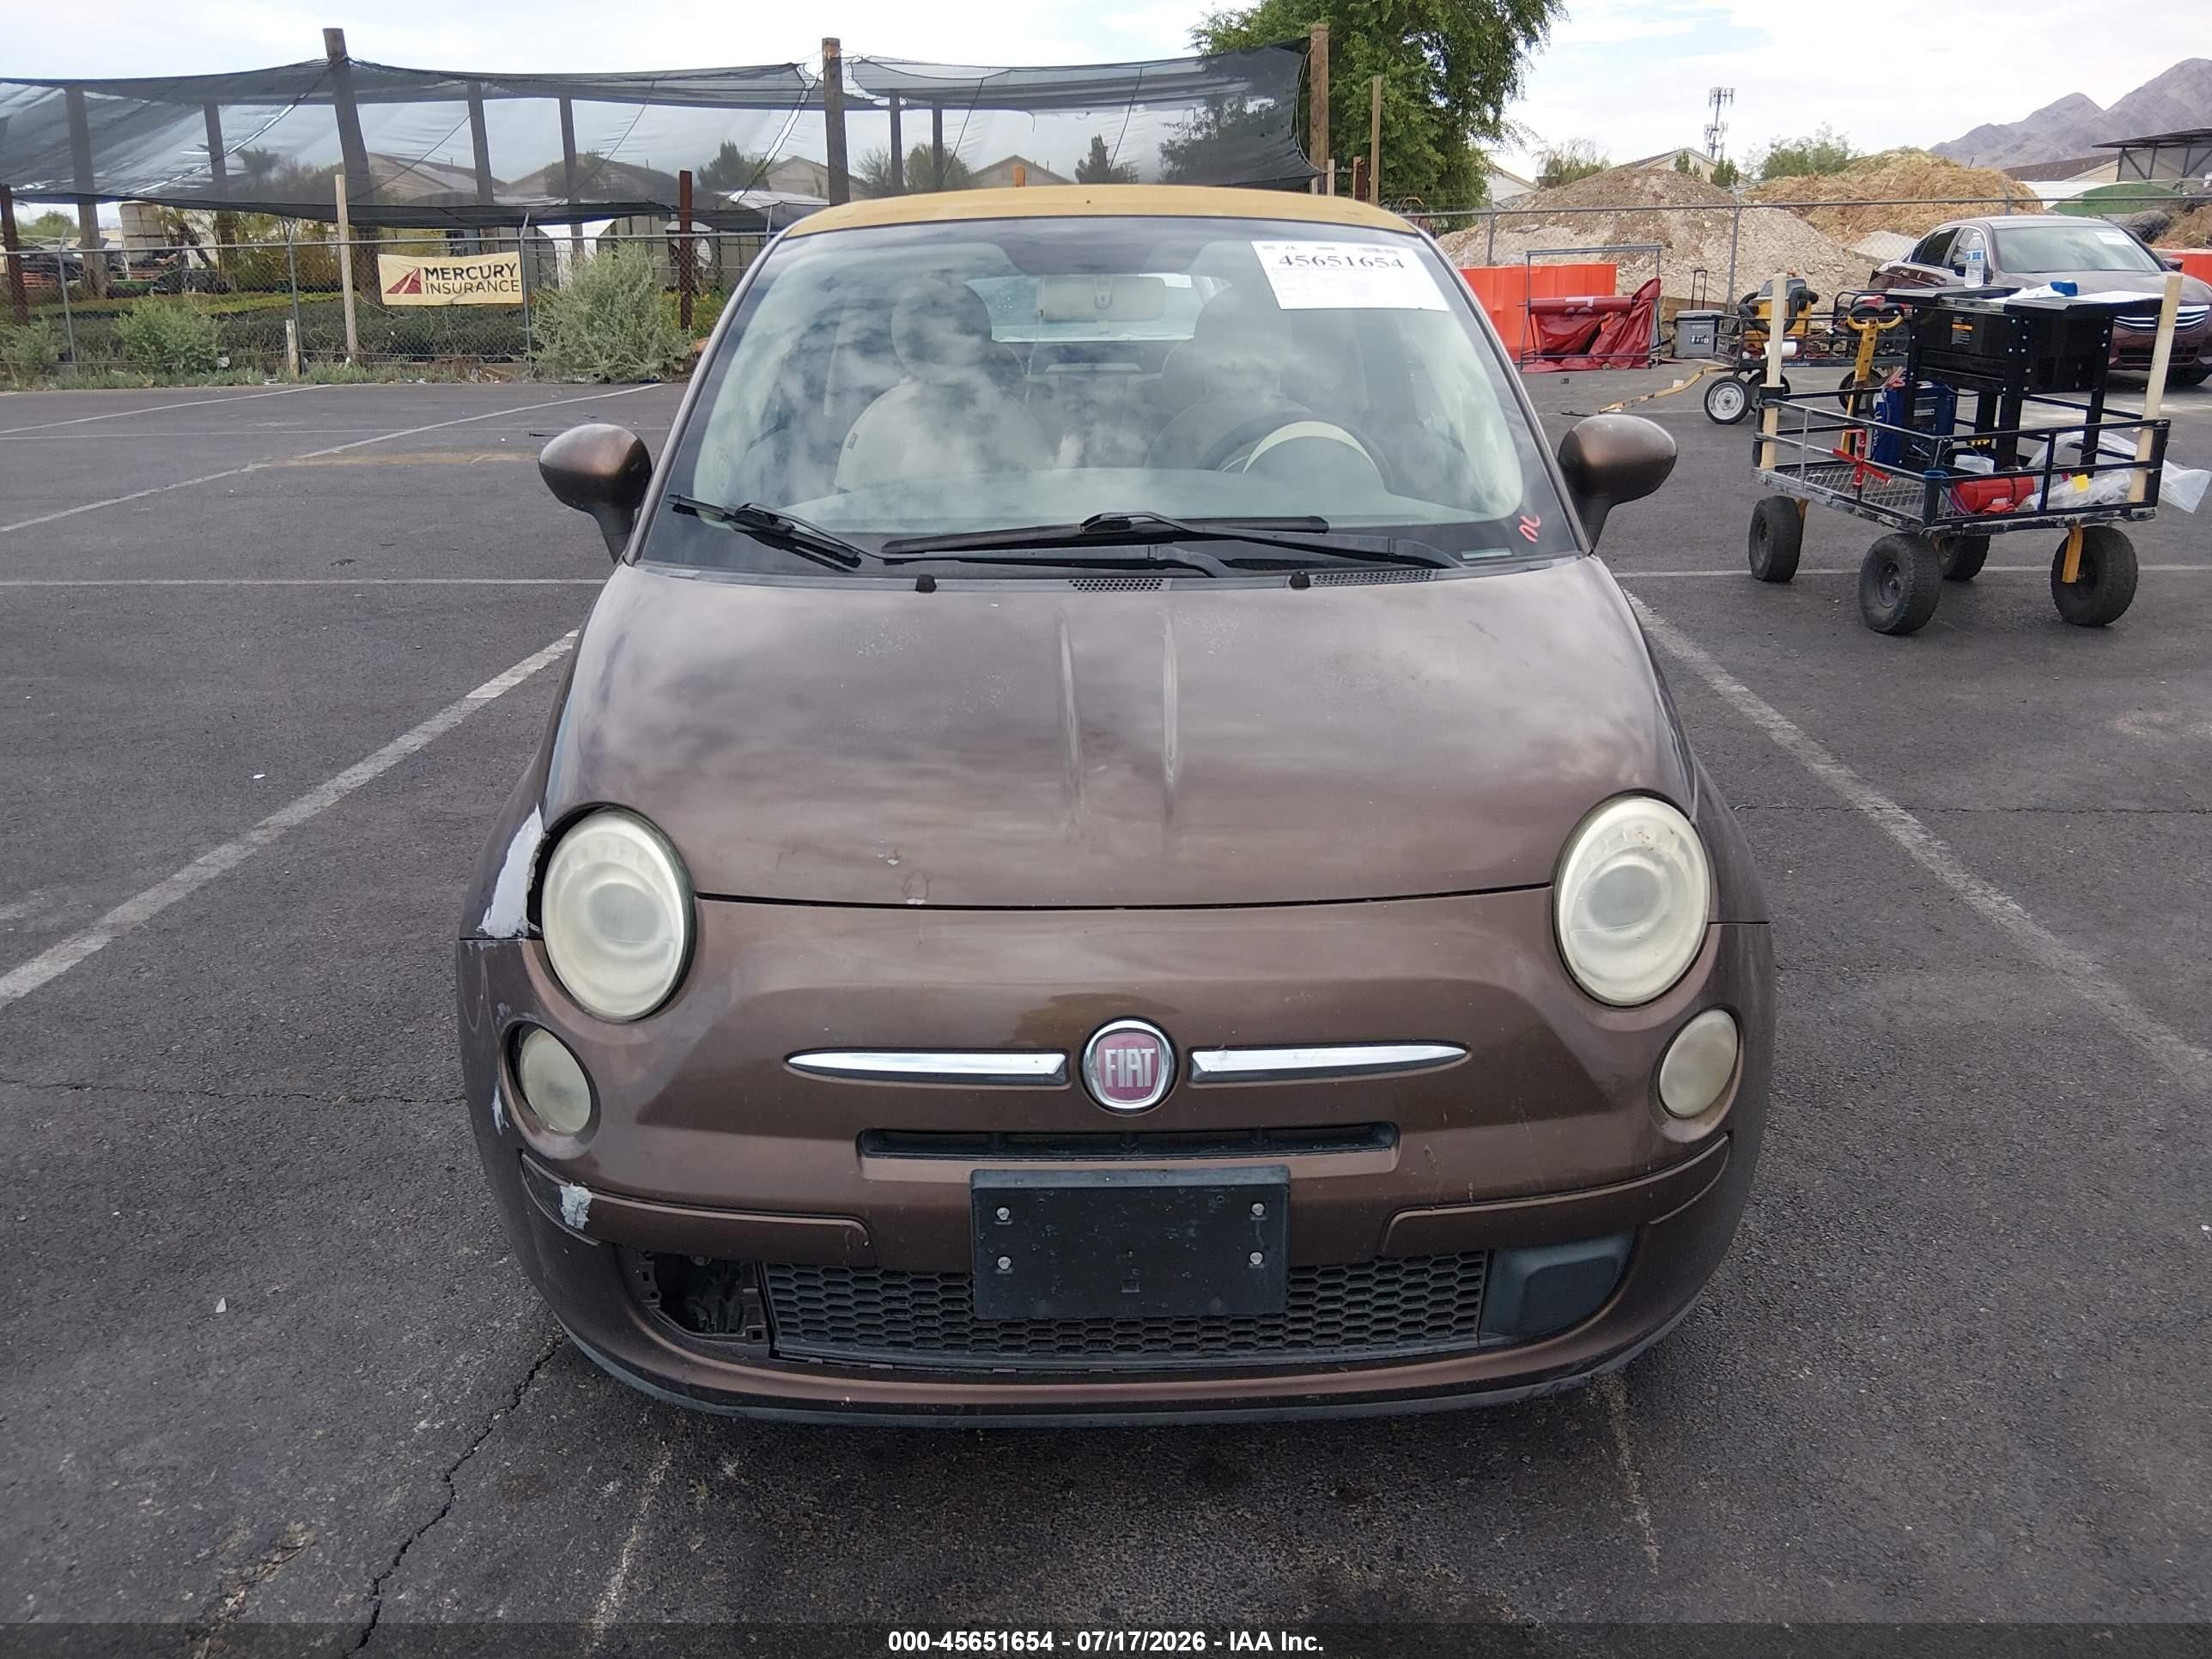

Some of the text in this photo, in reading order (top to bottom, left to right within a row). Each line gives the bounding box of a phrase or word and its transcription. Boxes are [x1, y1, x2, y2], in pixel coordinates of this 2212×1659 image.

[1279, 254, 1406, 268] 45651654
[424, 263, 517, 282] MERCURY
[425, 280, 520, 295] INSURANCE
[1105, 1048, 1155, 1087] FIAT
